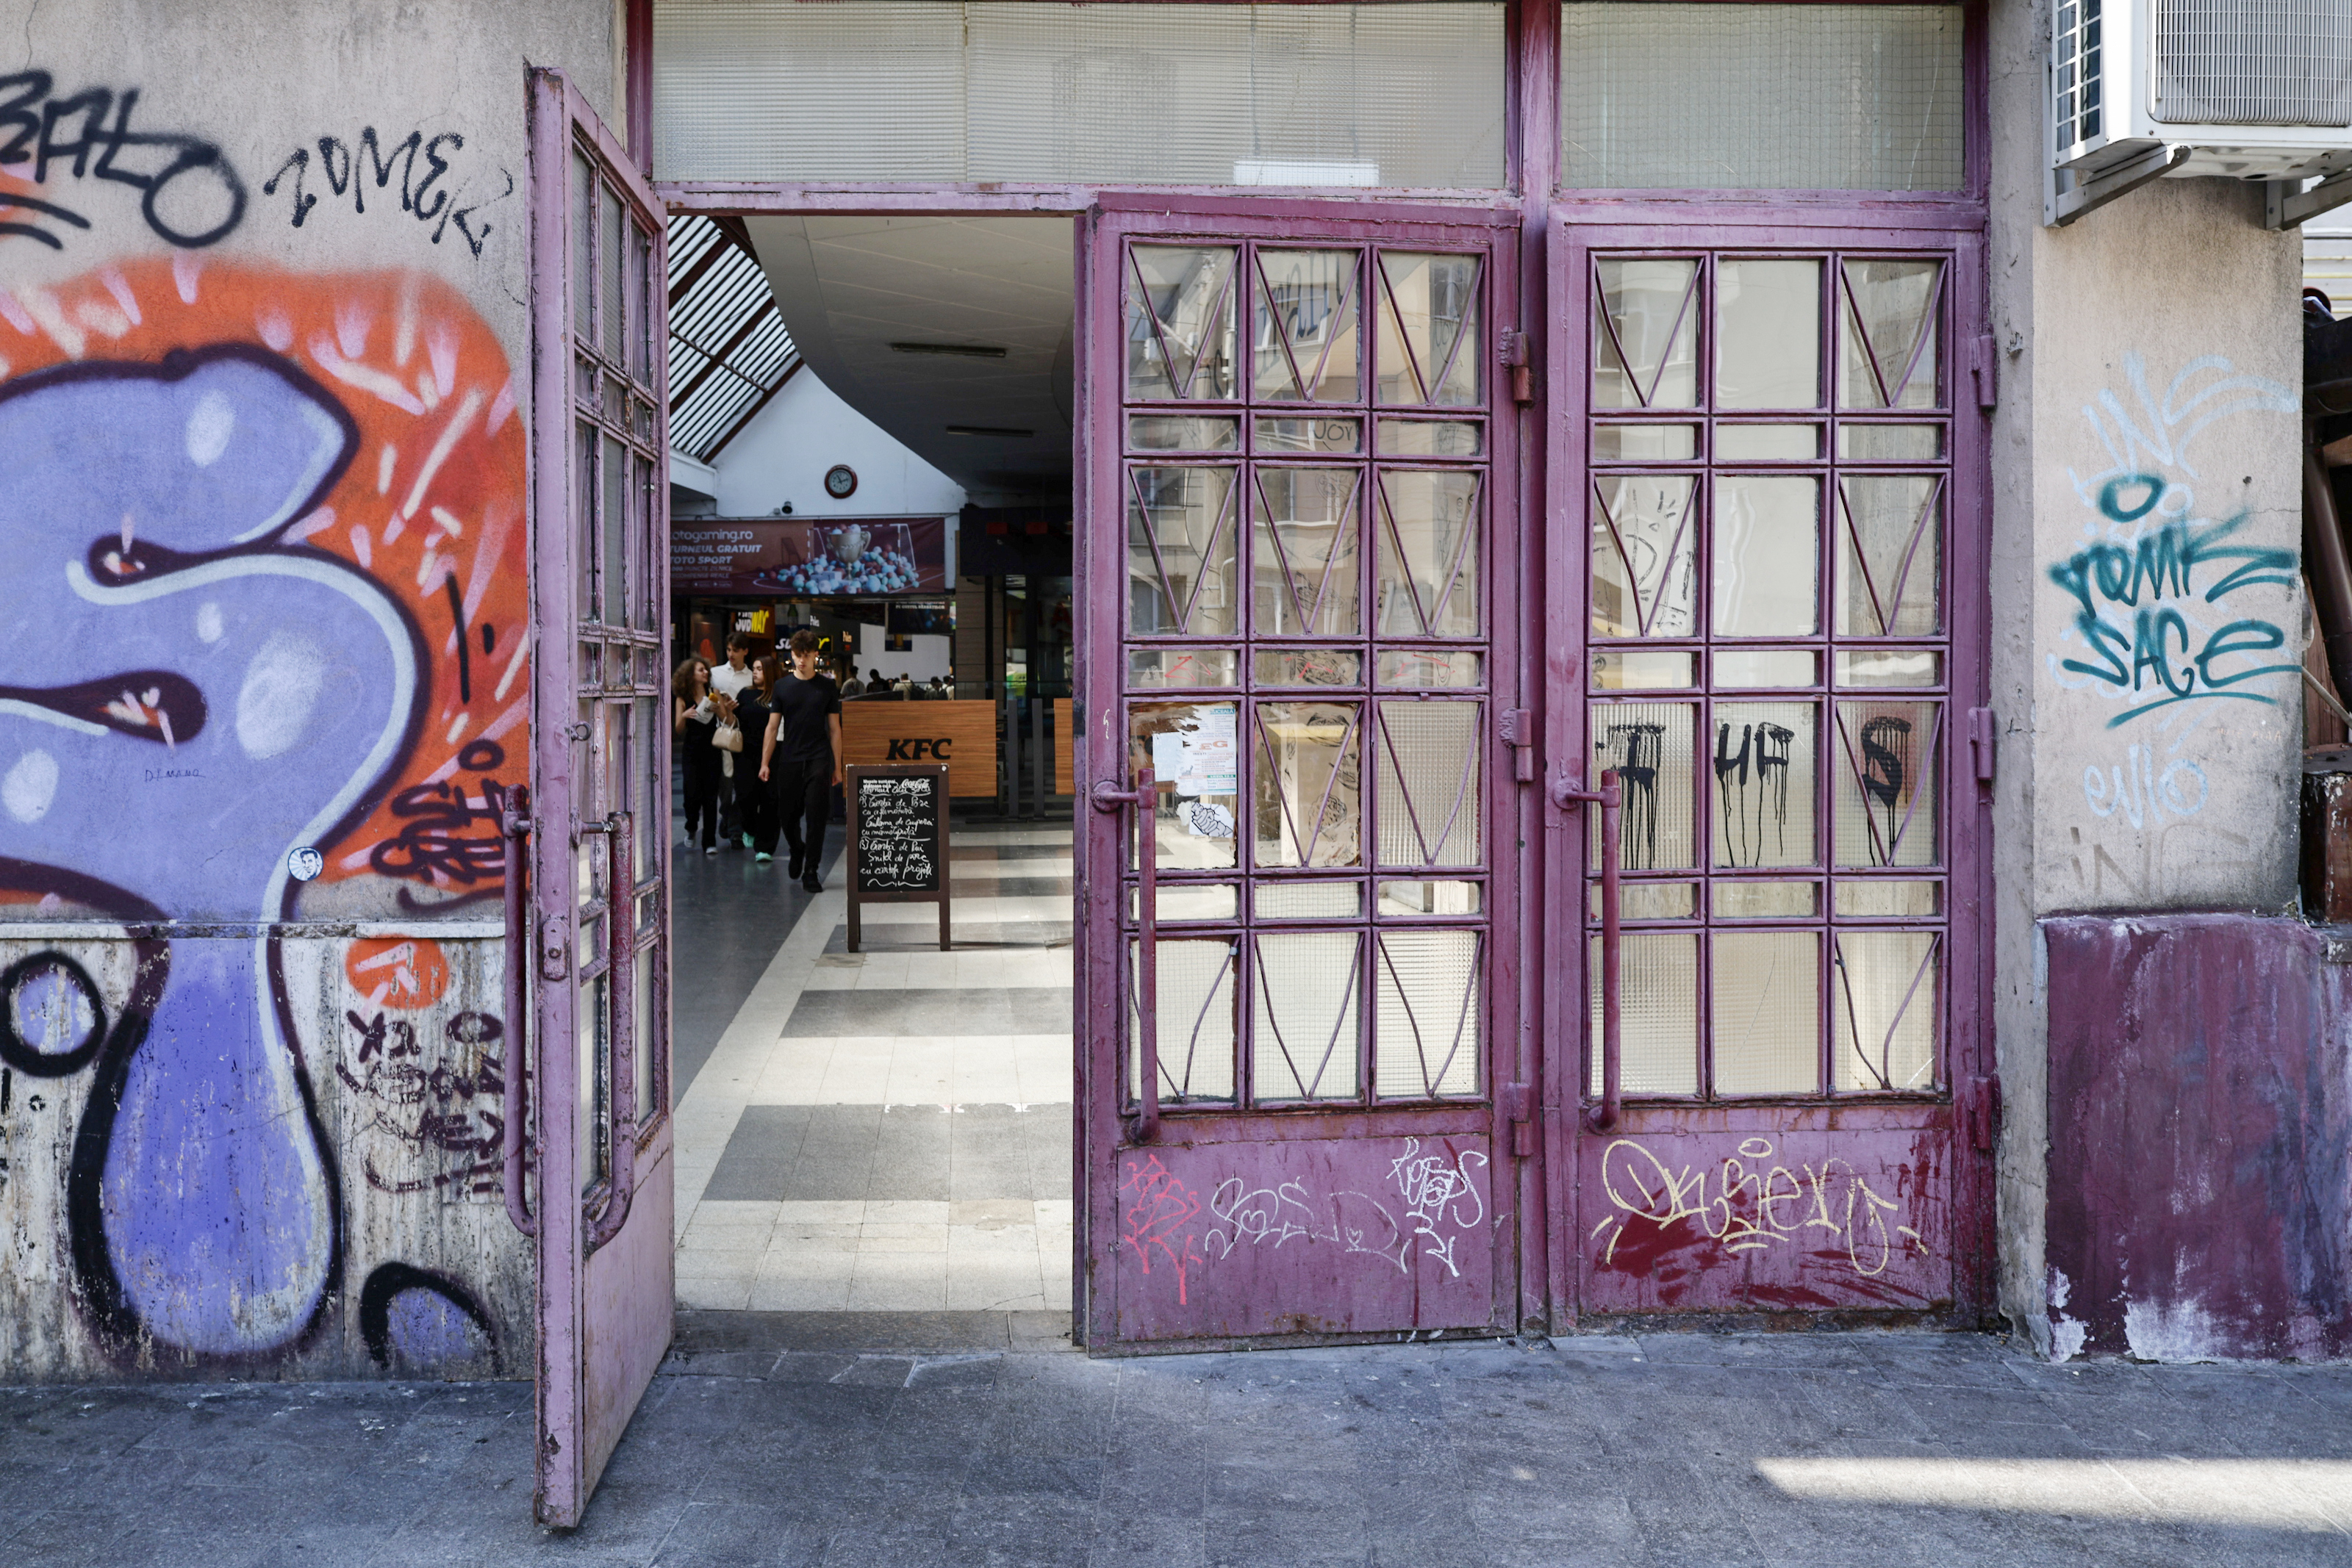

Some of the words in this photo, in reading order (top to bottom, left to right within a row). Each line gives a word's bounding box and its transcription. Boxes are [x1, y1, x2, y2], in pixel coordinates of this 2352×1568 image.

[670, 529, 753, 543] otogaming.ro
[670, 544, 714, 553] TURNEUL
[717, 544, 762, 553] GRATUIT
[698, 556, 733, 564] SPORT
[886, 738, 952, 760] KFC
[896, 798, 907, 808] de
[895, 816, 904, 825] de
[898, 841, 908, 852] de
[911, 841, 925, 852] Pui
[894, 854, 903, 862] de
[906, 853, 930, 867] porc
